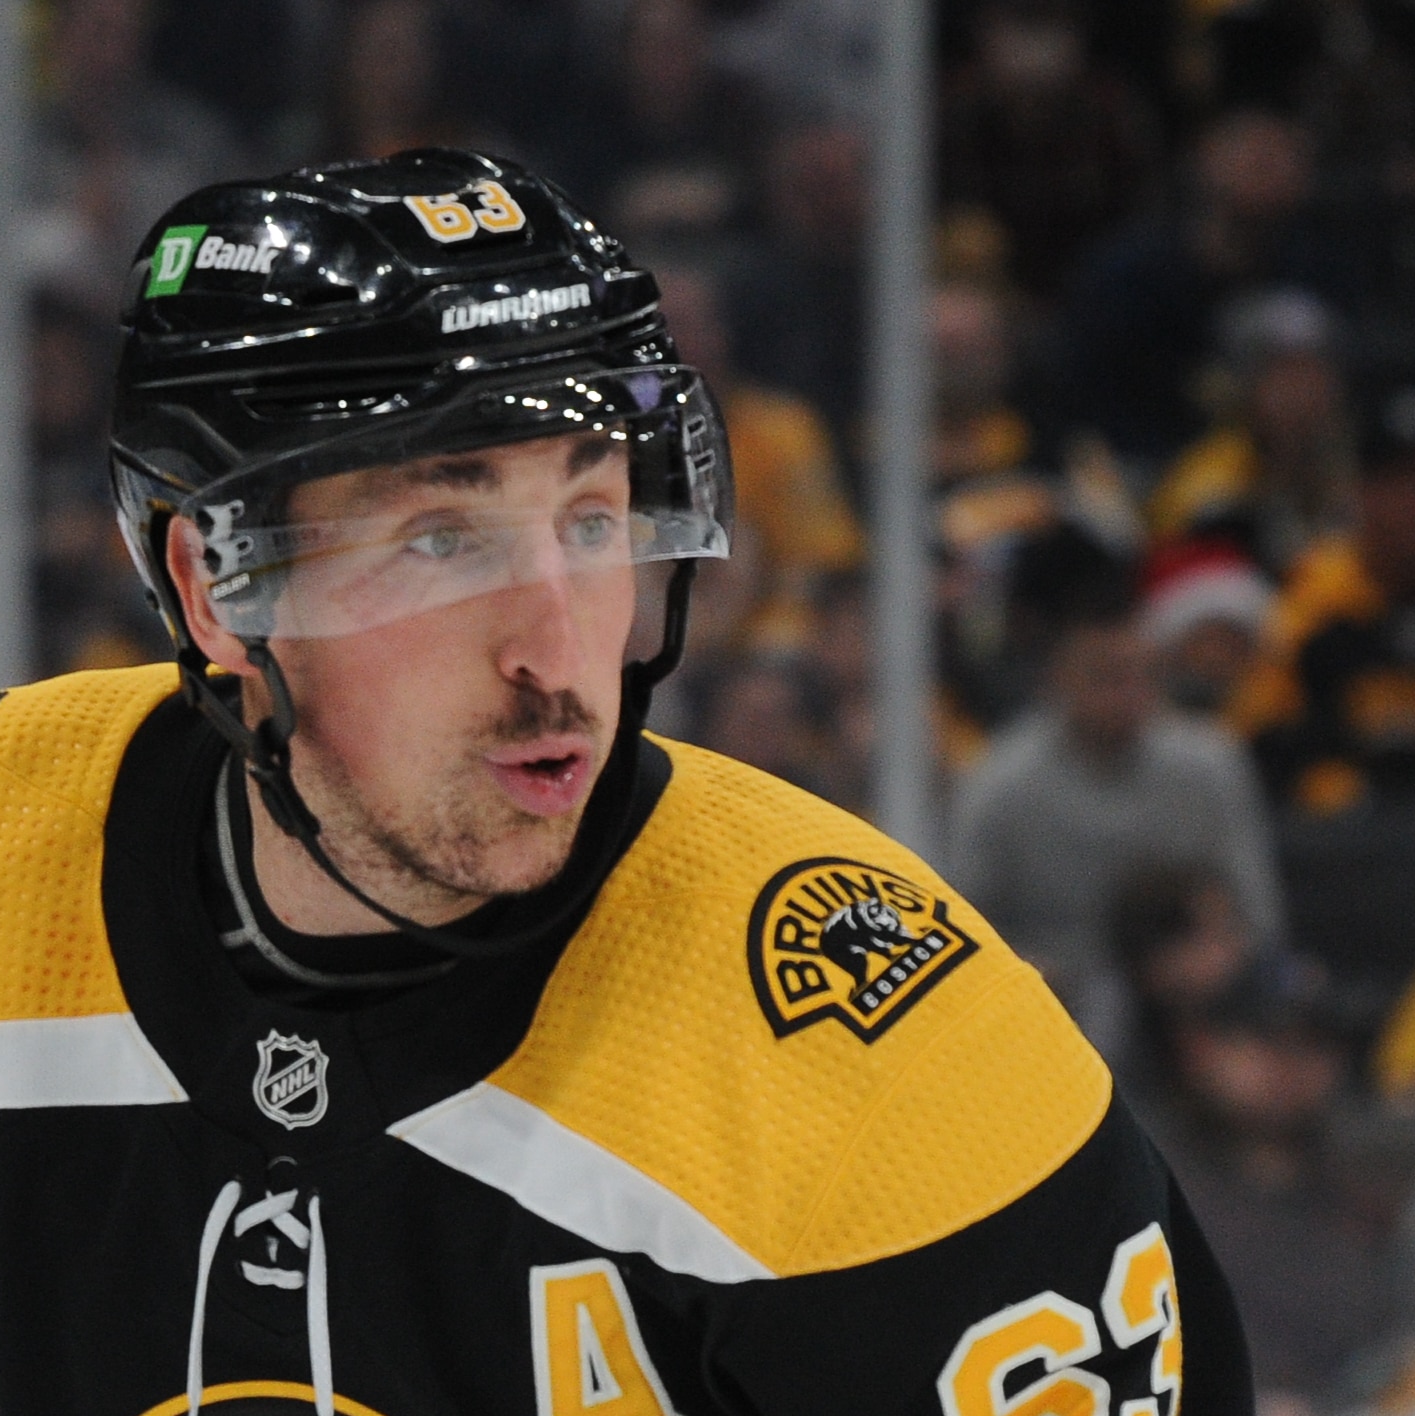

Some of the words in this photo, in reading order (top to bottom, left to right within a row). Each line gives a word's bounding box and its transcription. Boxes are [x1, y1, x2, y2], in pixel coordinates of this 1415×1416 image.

[403, 180, 526, 243] 63
[156, 236, 193, 283] TD
[195, 235, 281, 274] Bank
[441, 283, 591, 334] WARRIOR
[774, 871, 926, 1004] BRUINS
[270, 1063, 316, 1104] NHL
